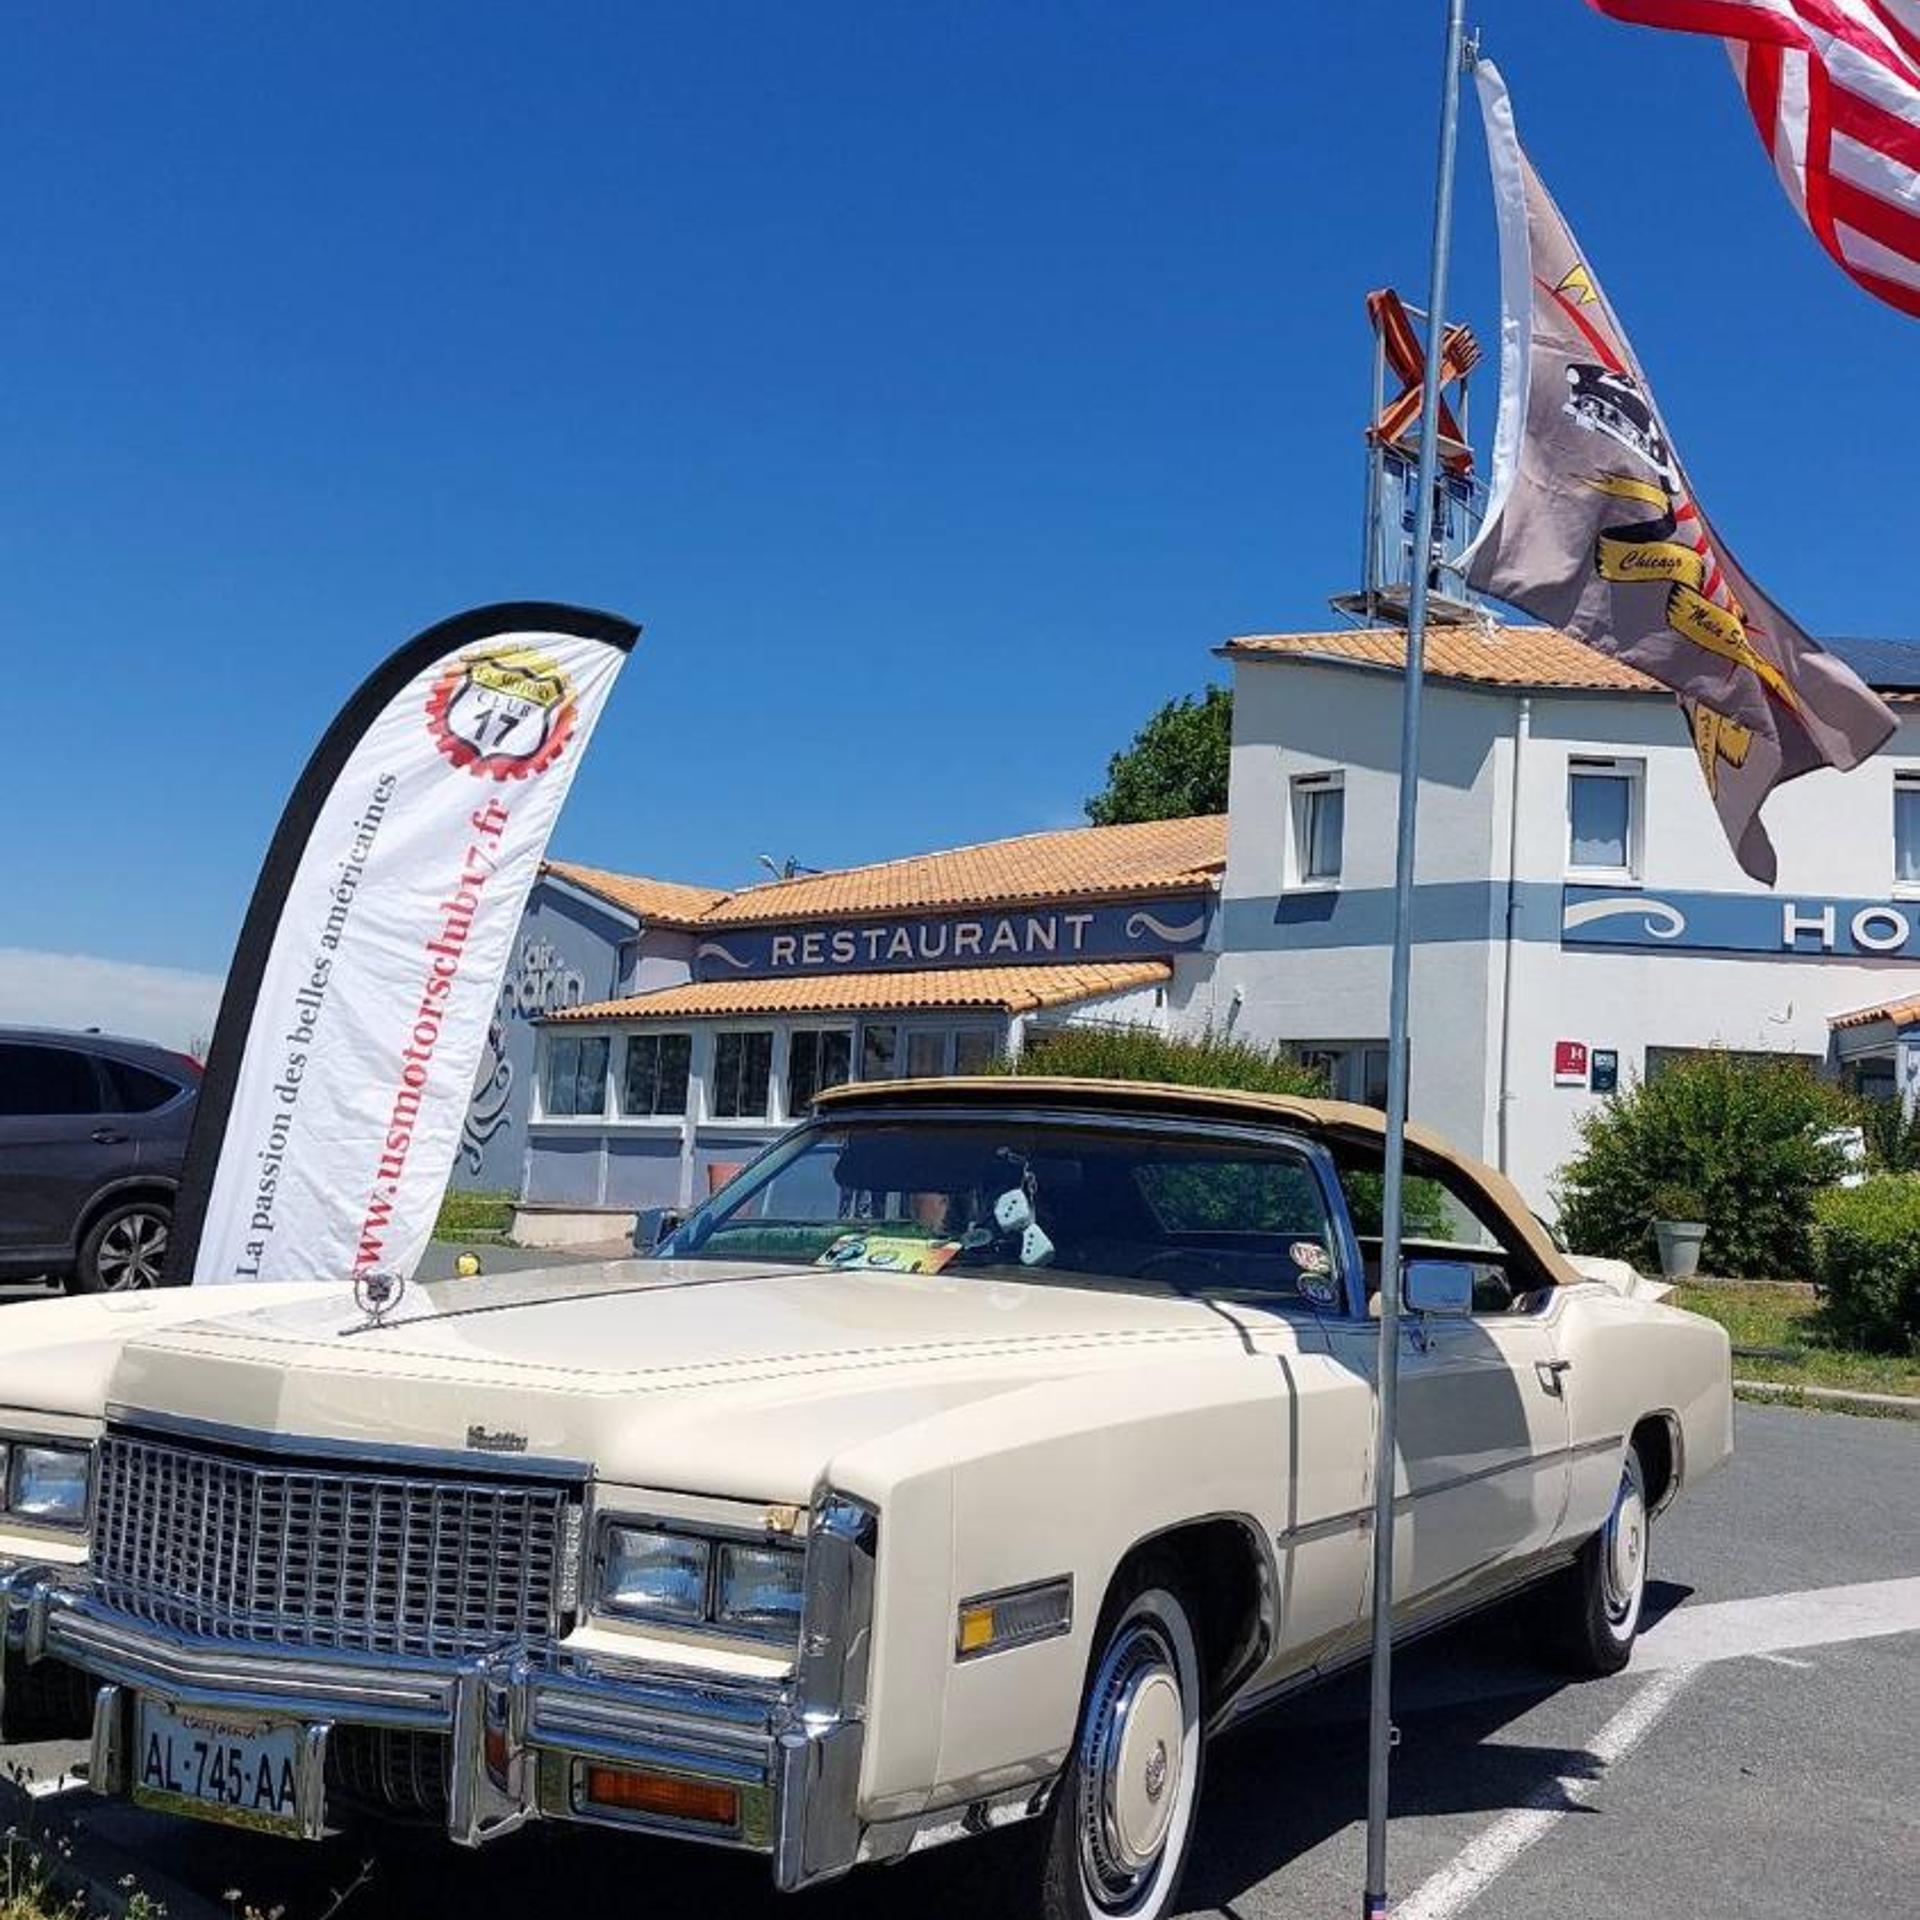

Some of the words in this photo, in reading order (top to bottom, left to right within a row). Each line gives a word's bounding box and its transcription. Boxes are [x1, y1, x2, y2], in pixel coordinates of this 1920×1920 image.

[474, 708, 520, 747] 17
[476, 692, 532, 718] CLUB
[320, 771, 397, 952] américaines
[771, 914, 1093, 966] RESTAURANT
[1783, 903, 1910, 950] HO
[286, 956, 333, 1046] belles
[272, 1052, 308, 1105] des
[250, 1112, 293, 1232] passion
[234, 1239, 266, 1280] La
